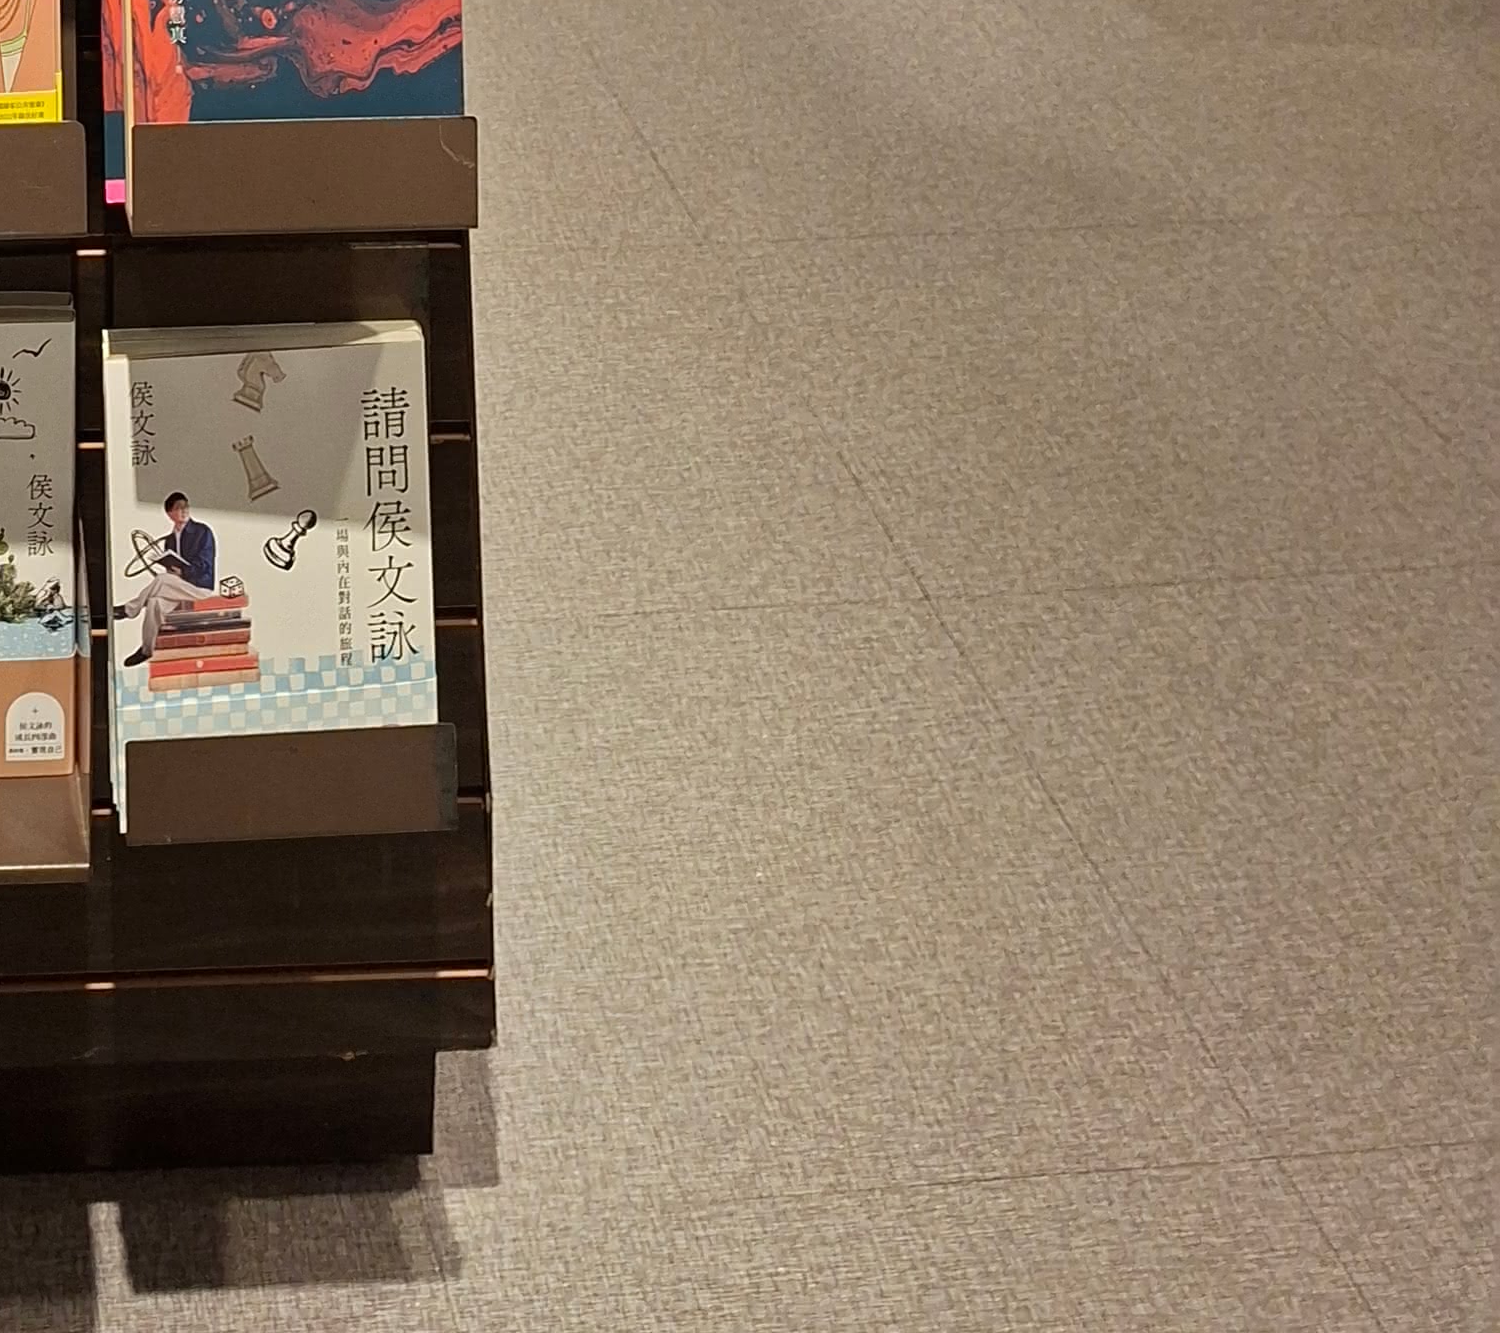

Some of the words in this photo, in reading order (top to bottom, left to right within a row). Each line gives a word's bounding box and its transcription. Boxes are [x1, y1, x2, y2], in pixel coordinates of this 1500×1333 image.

[130, 381, 158, 468] 侯文詠
[26, 474, 55, 558] 侯文詠
[361, 388, 420, 663] 請問侯文詠
